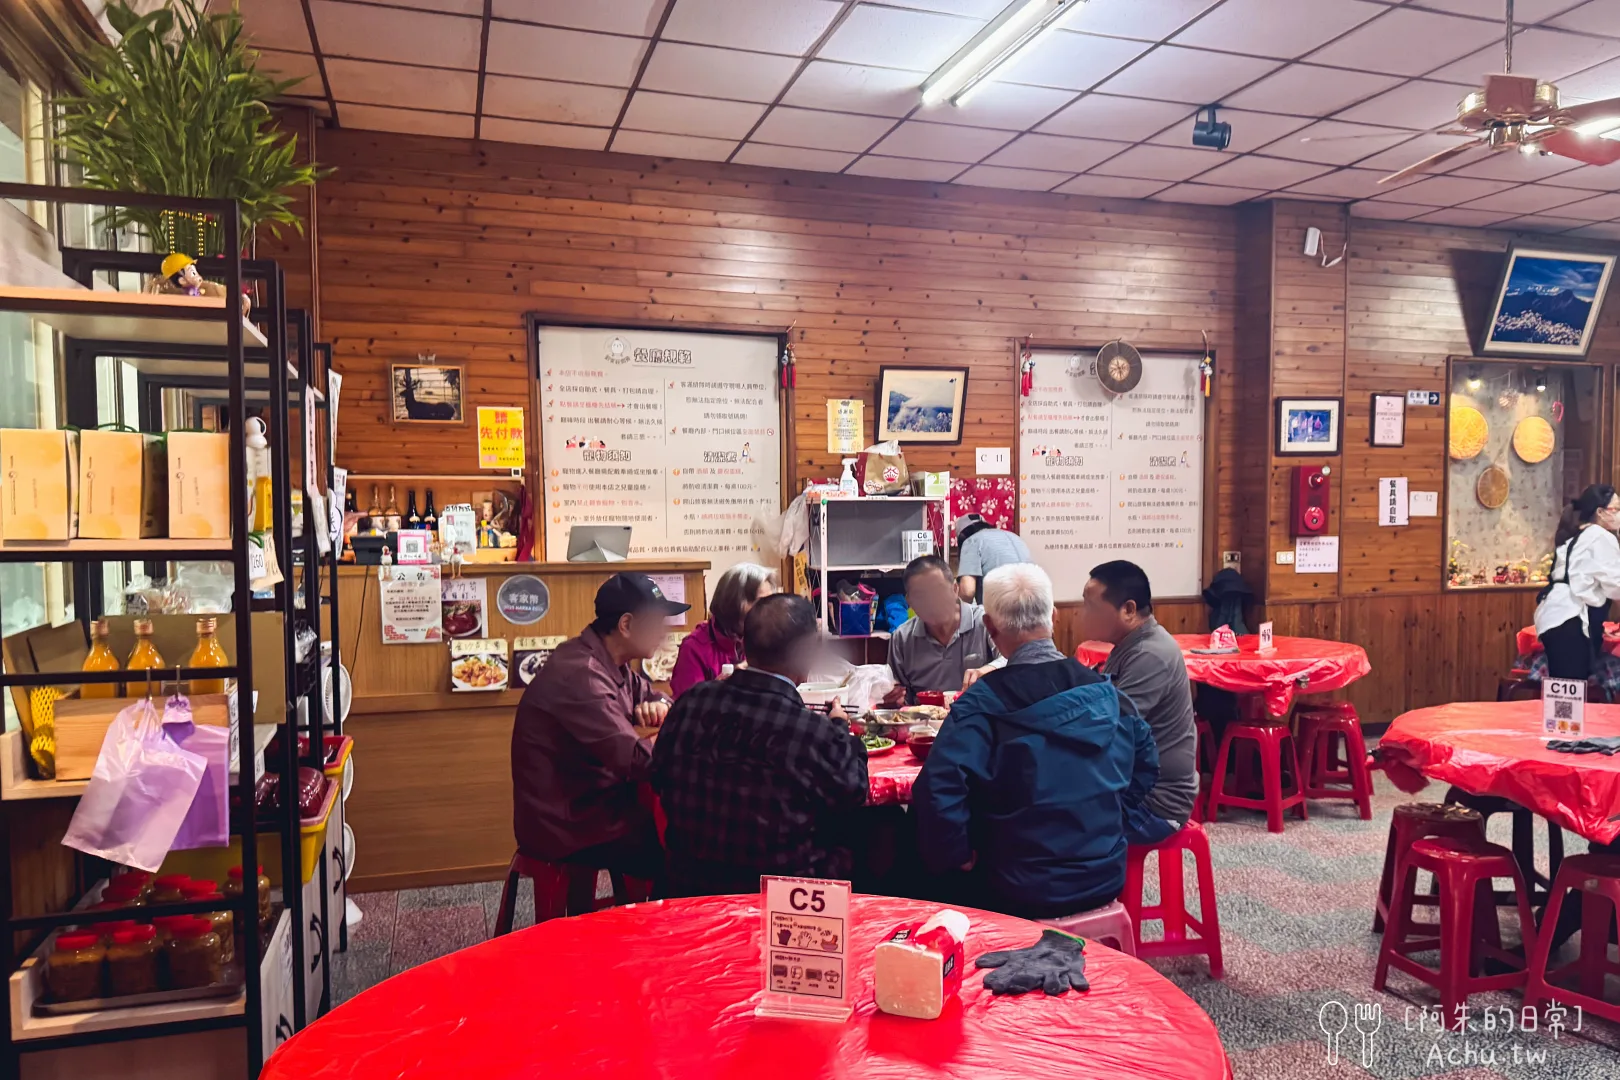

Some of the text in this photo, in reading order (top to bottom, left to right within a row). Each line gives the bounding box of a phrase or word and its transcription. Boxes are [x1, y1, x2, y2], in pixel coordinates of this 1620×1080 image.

[480, 426, 523, 441] 先付款
[980, 453, 988, 463] C
[1388, 479, 1397, 524] 餐具請自取
[1413, 494, 1420, 502] C
[397, 572, 425, 581] 公告
[1550, 682, 1577, 695] C10
[789, 887, 826, 913] C5
